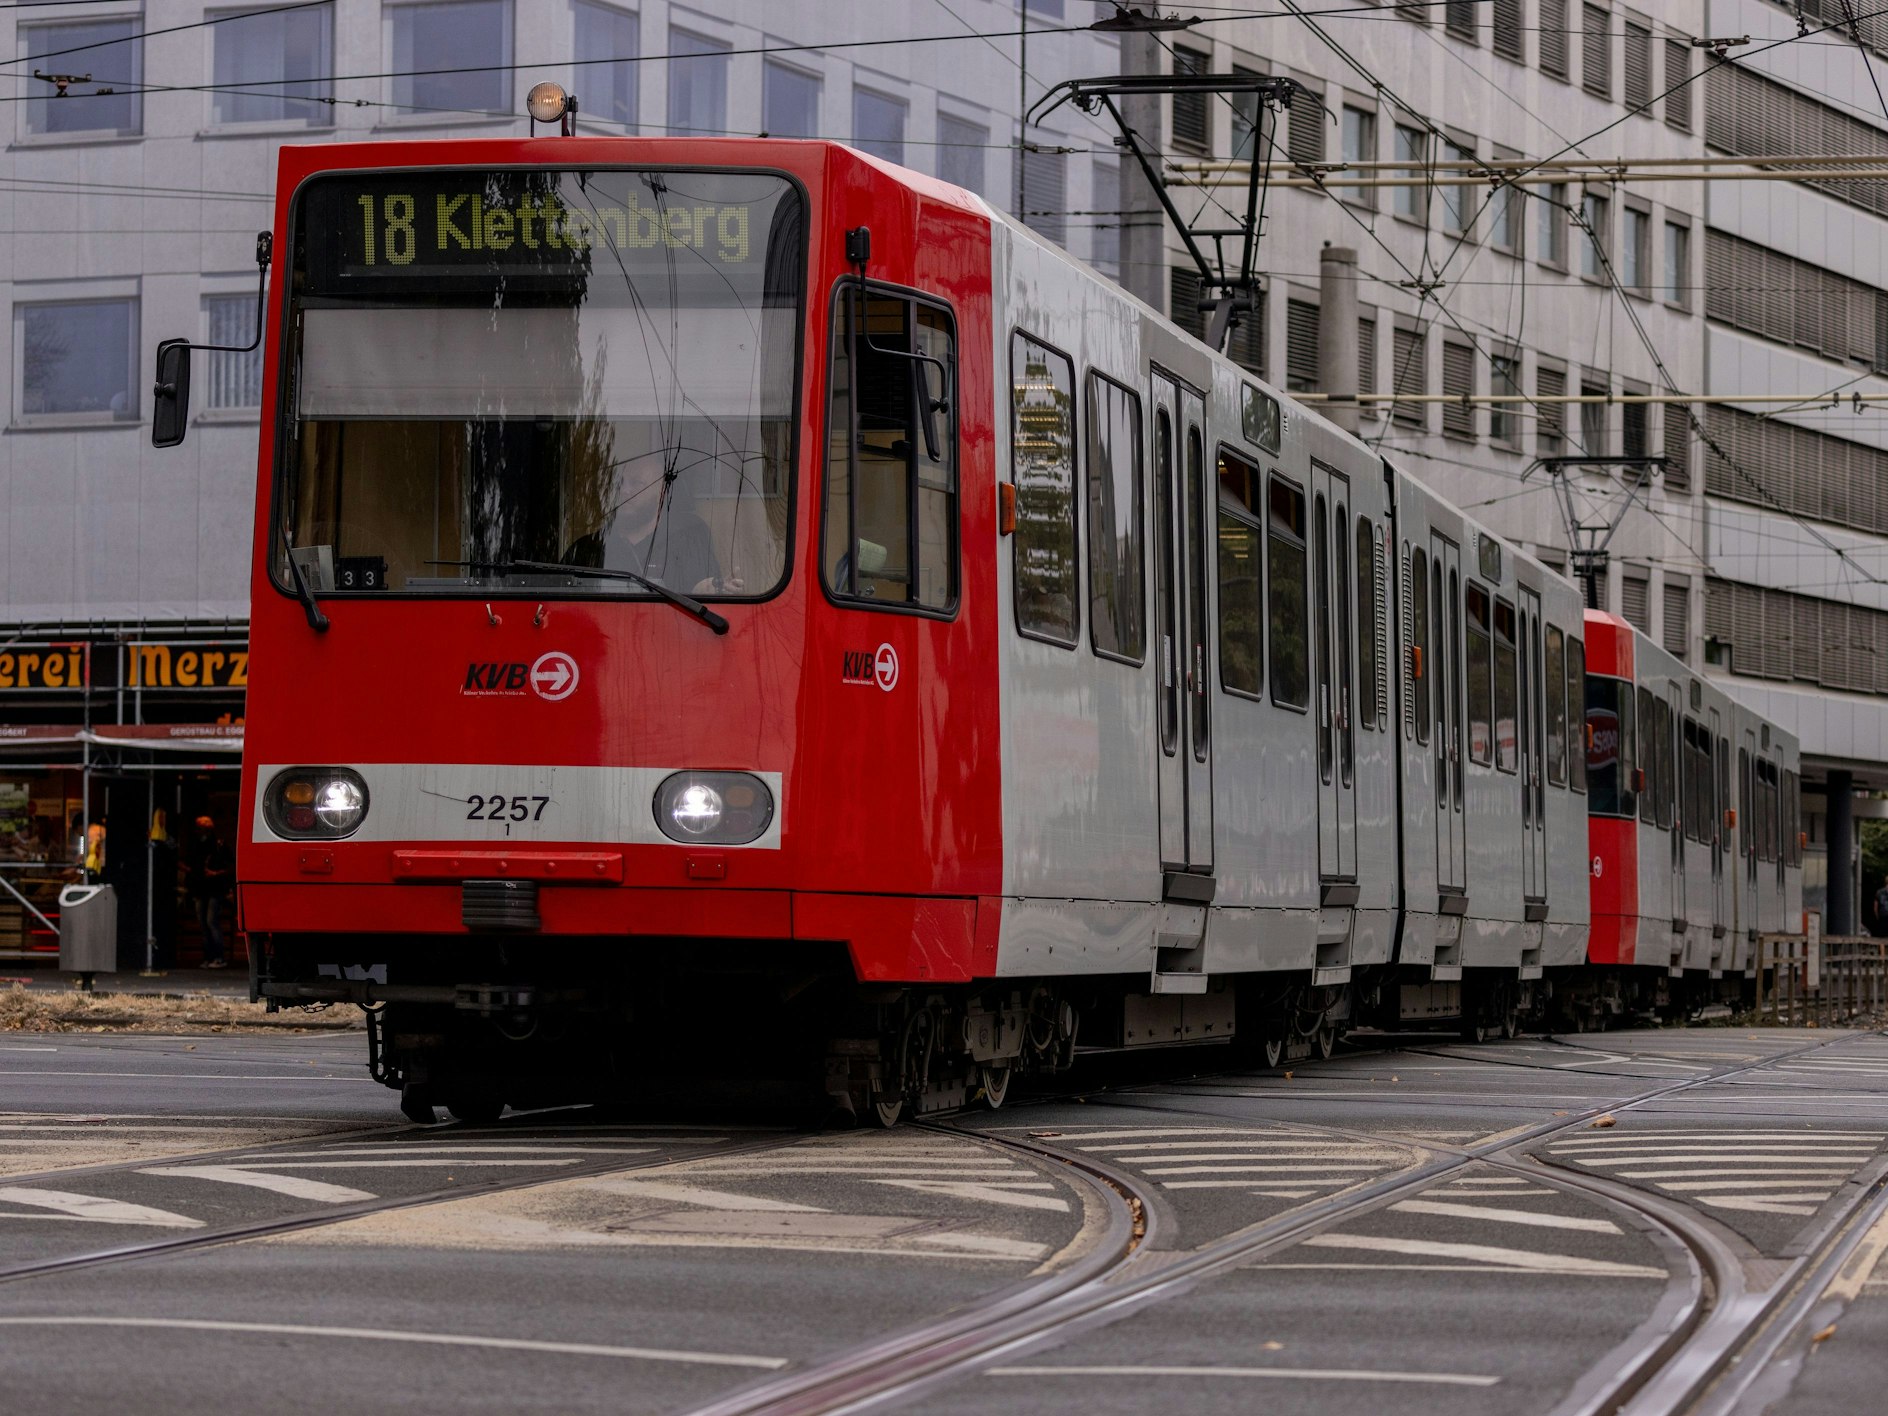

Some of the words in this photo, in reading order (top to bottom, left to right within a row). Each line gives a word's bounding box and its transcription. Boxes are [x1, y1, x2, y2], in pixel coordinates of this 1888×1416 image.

[357, 193, 415, 265] 18
[436, 191, 749, 264] Klettenberg
[464, 663, 529, 690] KVB
[843, 651, 875, 679] KVB
[467, 794, 550, 822] 2257
